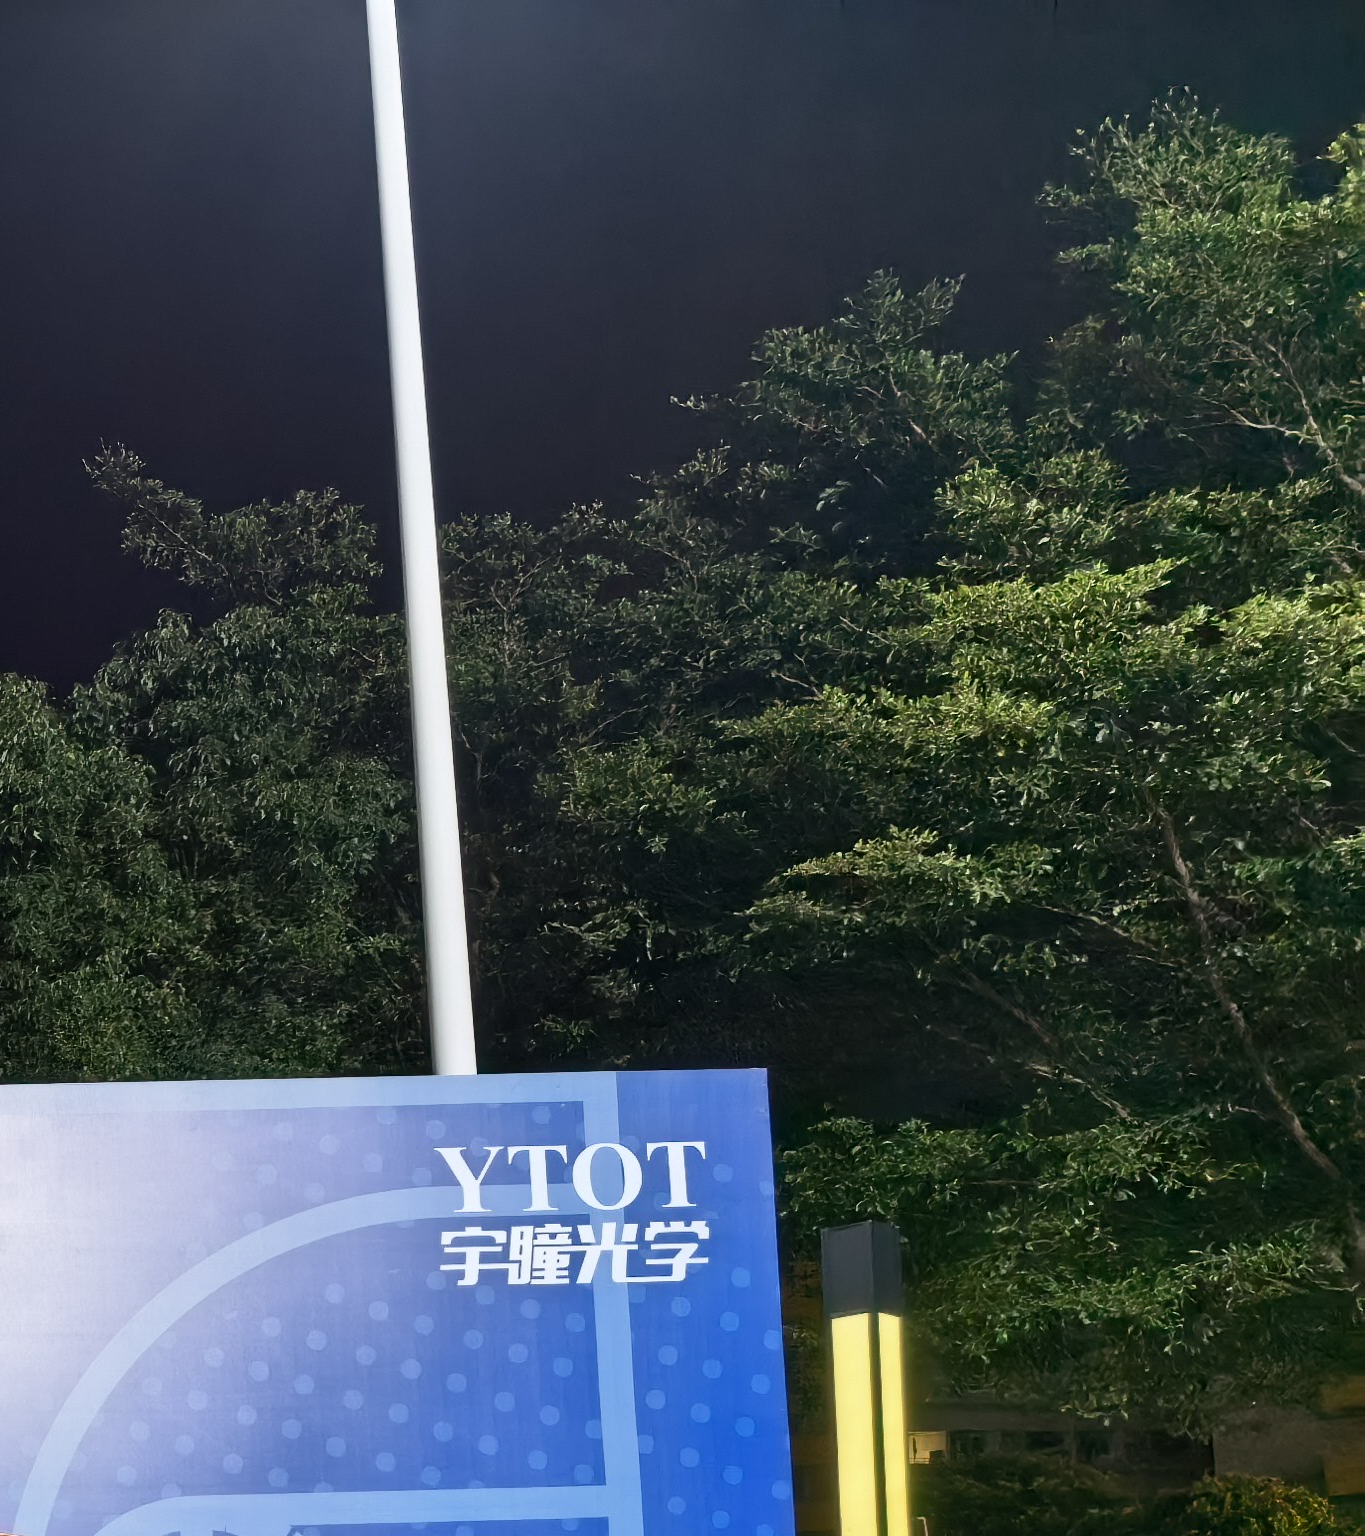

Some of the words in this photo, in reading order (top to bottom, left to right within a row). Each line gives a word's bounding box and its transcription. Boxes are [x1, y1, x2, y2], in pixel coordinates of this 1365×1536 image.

[434, 1141, 707, 1213] YTOT
[440, 1220, 709, 1287] 宇瞳光学
